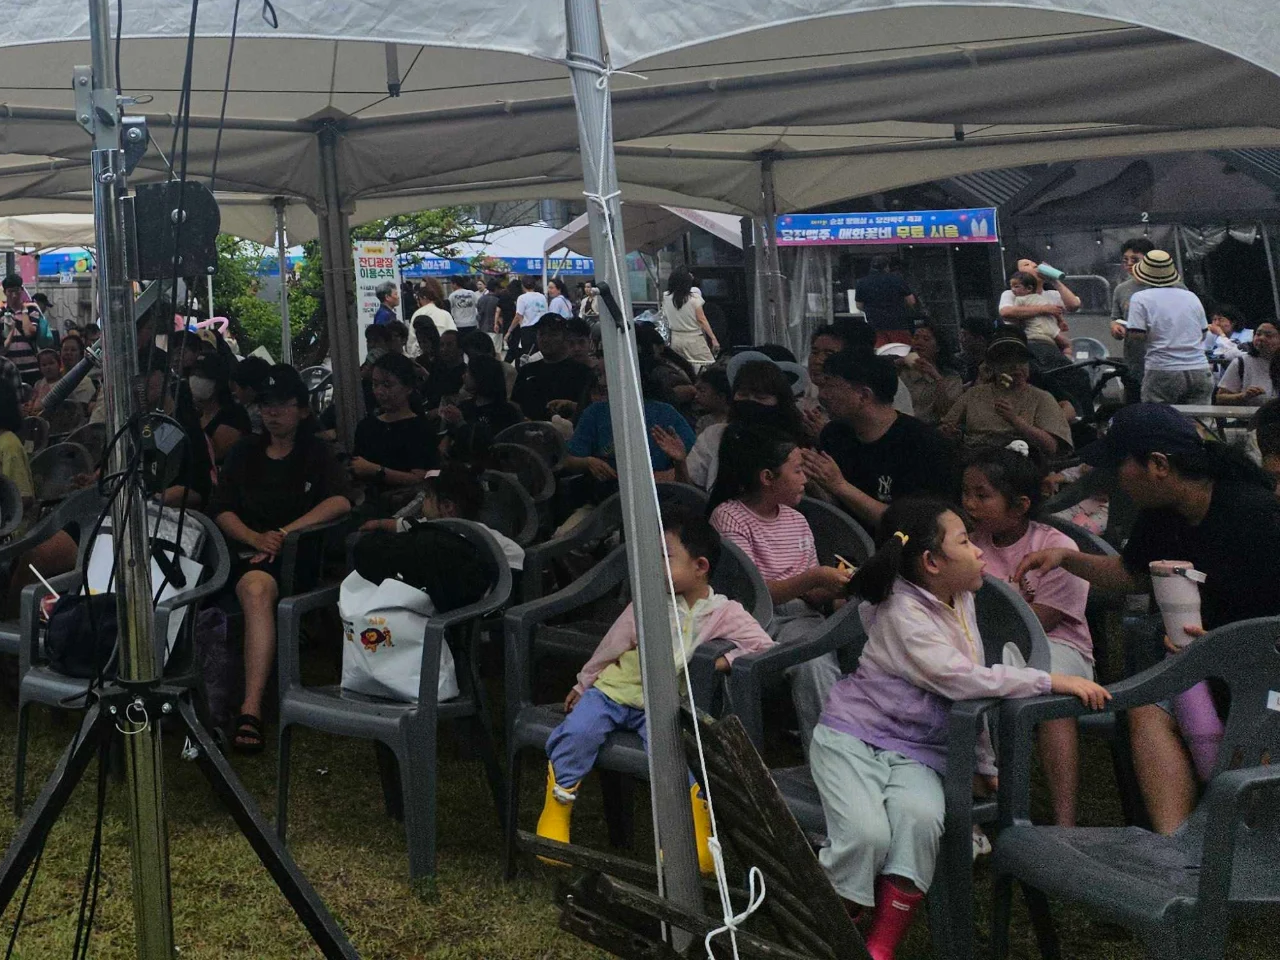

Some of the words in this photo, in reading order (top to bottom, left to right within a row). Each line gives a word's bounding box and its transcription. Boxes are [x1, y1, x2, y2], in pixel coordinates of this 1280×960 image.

[1141, 212, 1149, 222] 2
[896, 225, 925, 238] 무료
[930, 224, 959, 238] 시음
[359, 257, 393, 268] 잔디광장
